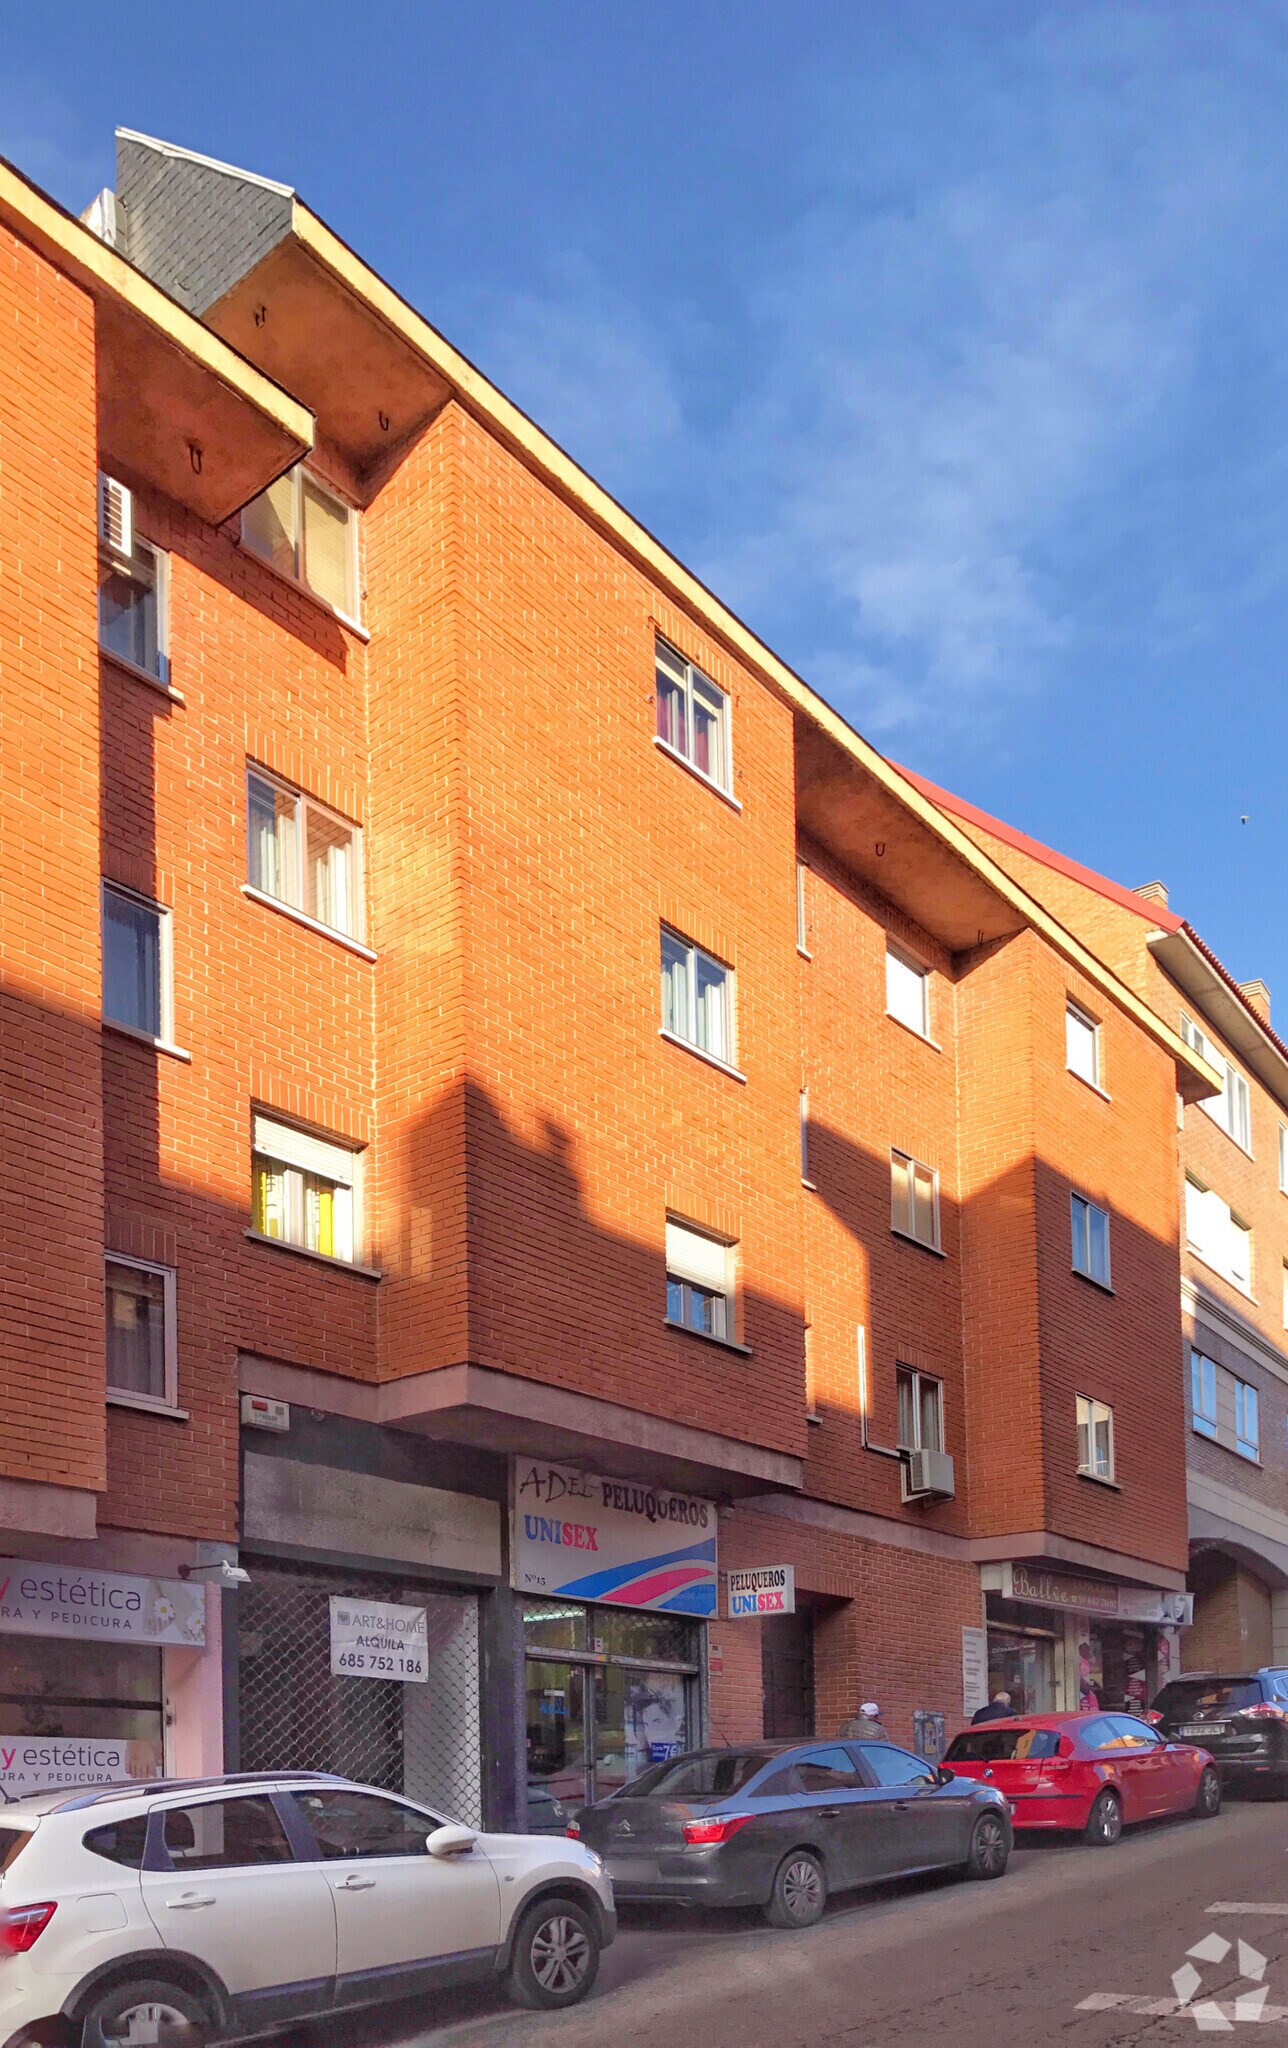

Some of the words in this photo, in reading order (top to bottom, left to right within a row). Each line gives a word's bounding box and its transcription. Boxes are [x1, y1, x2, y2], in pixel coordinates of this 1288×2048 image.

[602, 1482, 708, 1529] PELUQUEROS
[524, 1514, 599, 1551] UNISEX
[730, 1569, 786, 1593] PELUQUEROS
[20, 1576, 142, 1611] estética
[732, 1591, 784, 1614] UNISEX
[32, 1609, 41, 1620] Y
[51, 1611, 133, 1630] PEDICURA
[352, 1614, 425, 1634] ART&HOME
[356, 1635, 405, 1650] ALQUILA
[339, 1653, 365, 1668] 685
[370, 1655, 394, 1671] 752
[399, 1658, 422, 1674] 186
[1, 1748, 17, 1770] y
[23, 1743, 120, 1767] estética
[33, 1772, 41, 1781] Y
[48, 1773, 113, 1782] PEDICURA
